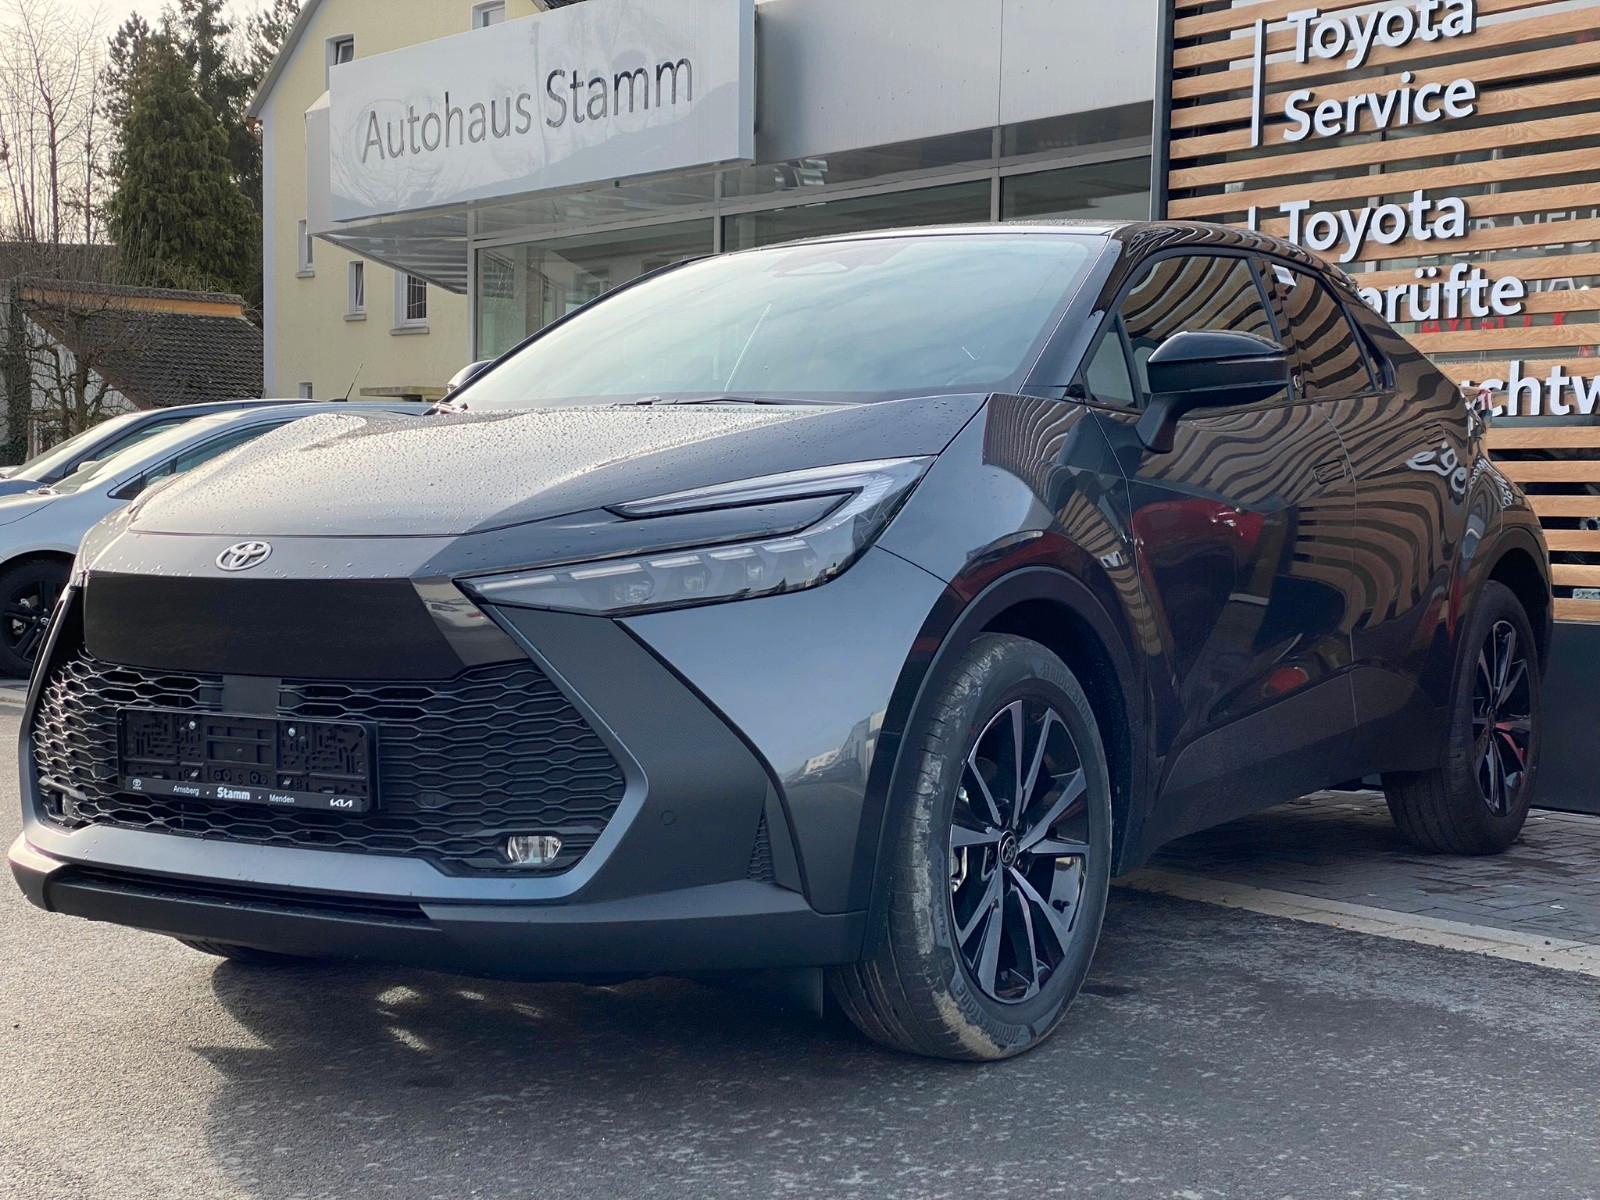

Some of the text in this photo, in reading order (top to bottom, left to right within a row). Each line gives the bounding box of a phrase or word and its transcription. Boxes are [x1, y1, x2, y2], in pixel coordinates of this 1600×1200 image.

[1286, 0, 1475, 69] Toyota
[361, 57, 694, 163] Autohaus Stamm
[1283, 70, 1477, 141] Service
[1279, 189, 1466, 263] Toyota
[172, 784, 295, 804] Arnsberg Stamm Menden
